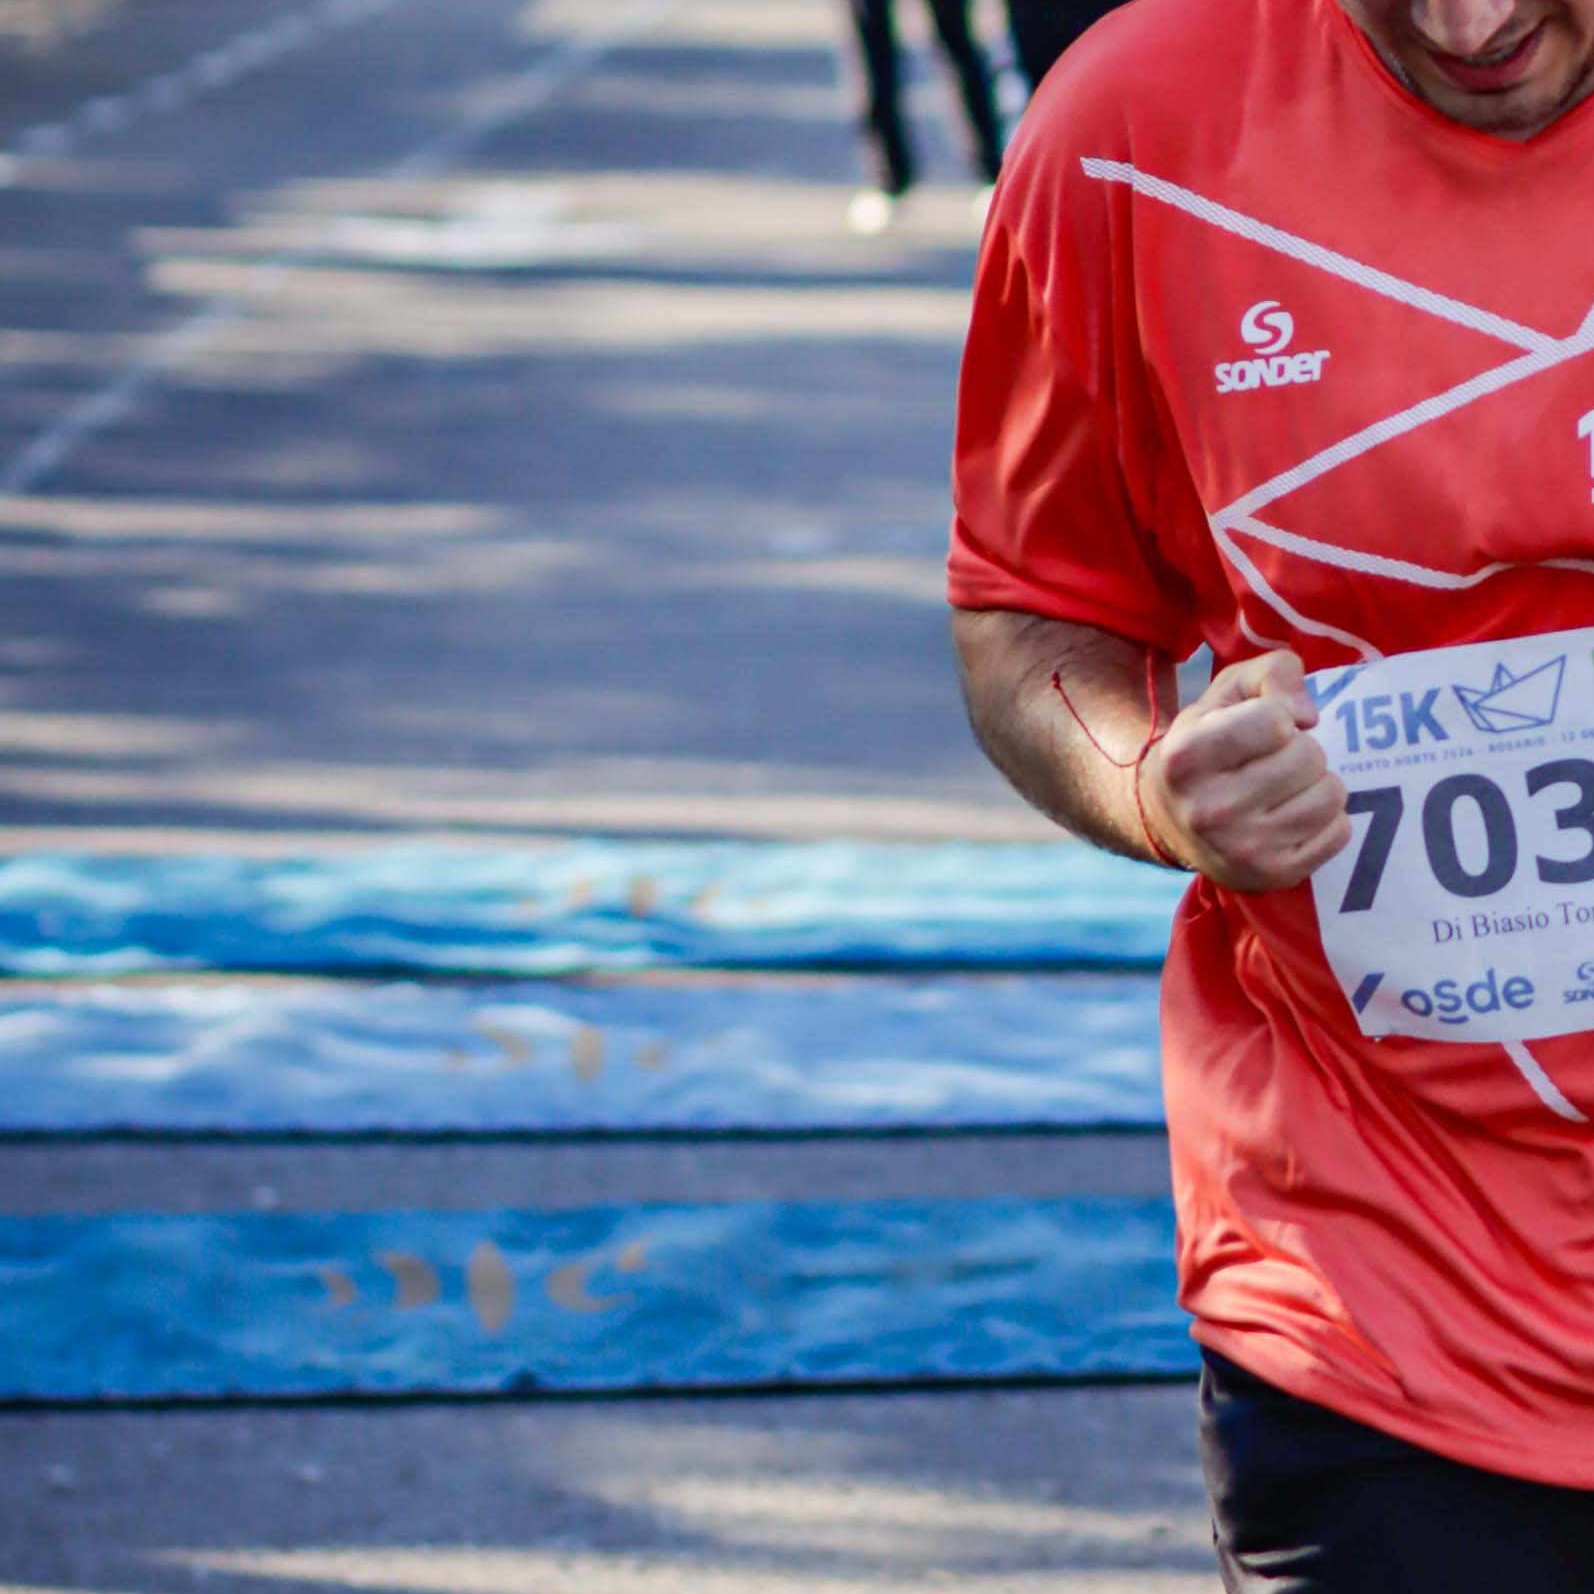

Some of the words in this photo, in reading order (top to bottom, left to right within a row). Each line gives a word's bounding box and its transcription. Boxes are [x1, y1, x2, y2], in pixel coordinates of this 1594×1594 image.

[1336, 688, 1451, 754] 15K
[1432, 918, 1463, 943] Di
[1471, 909, 1550, 938] Biasio
[1401, 967, 1535, 1018] osde
